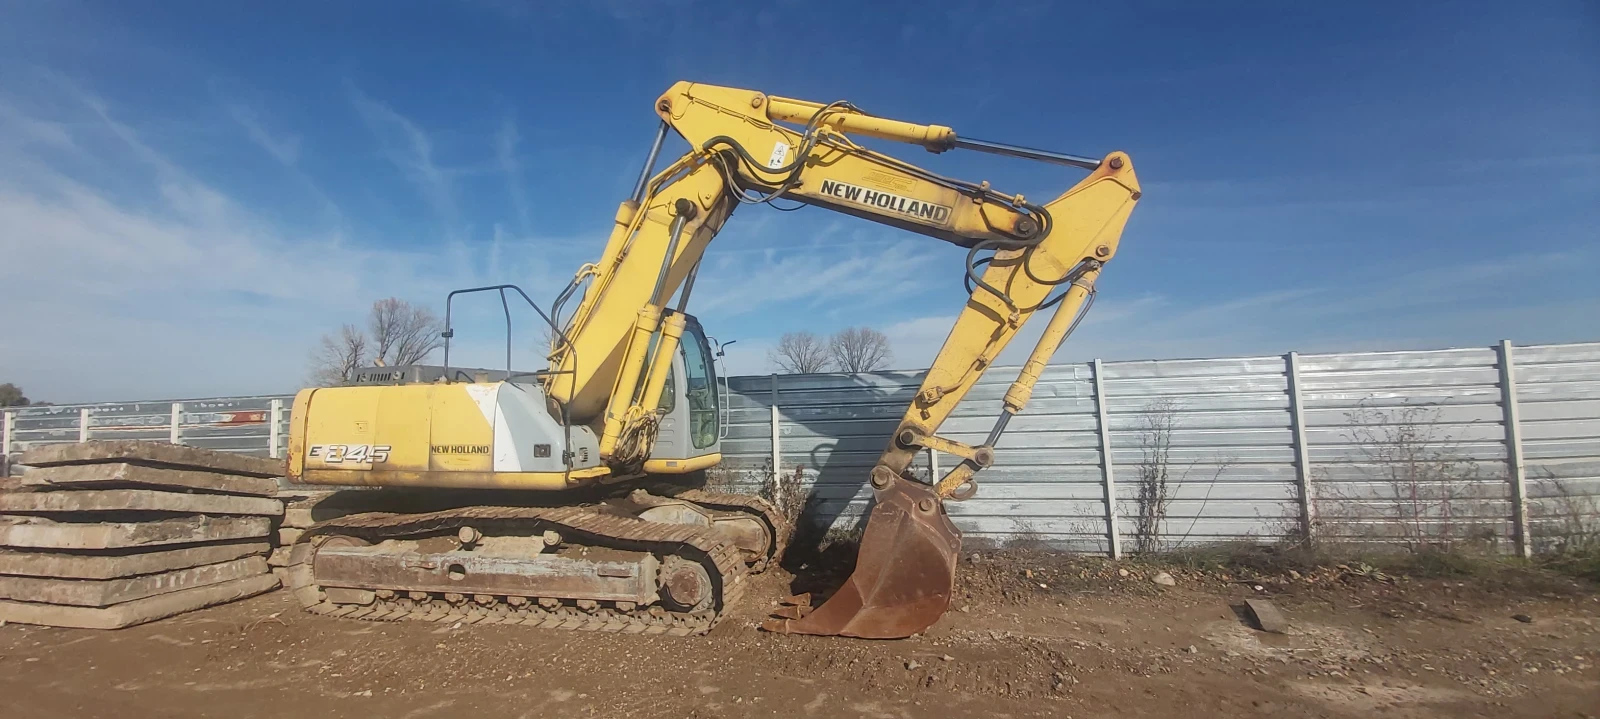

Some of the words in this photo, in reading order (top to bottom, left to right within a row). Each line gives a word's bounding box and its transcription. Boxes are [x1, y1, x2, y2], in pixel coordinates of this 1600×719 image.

[820, 180, 863, 201] NEW
[863, 190, 948, 221] HOLLAND
[431, 445, 449, 454] NEW
[450, 445, 490, 454] HOLLAND
